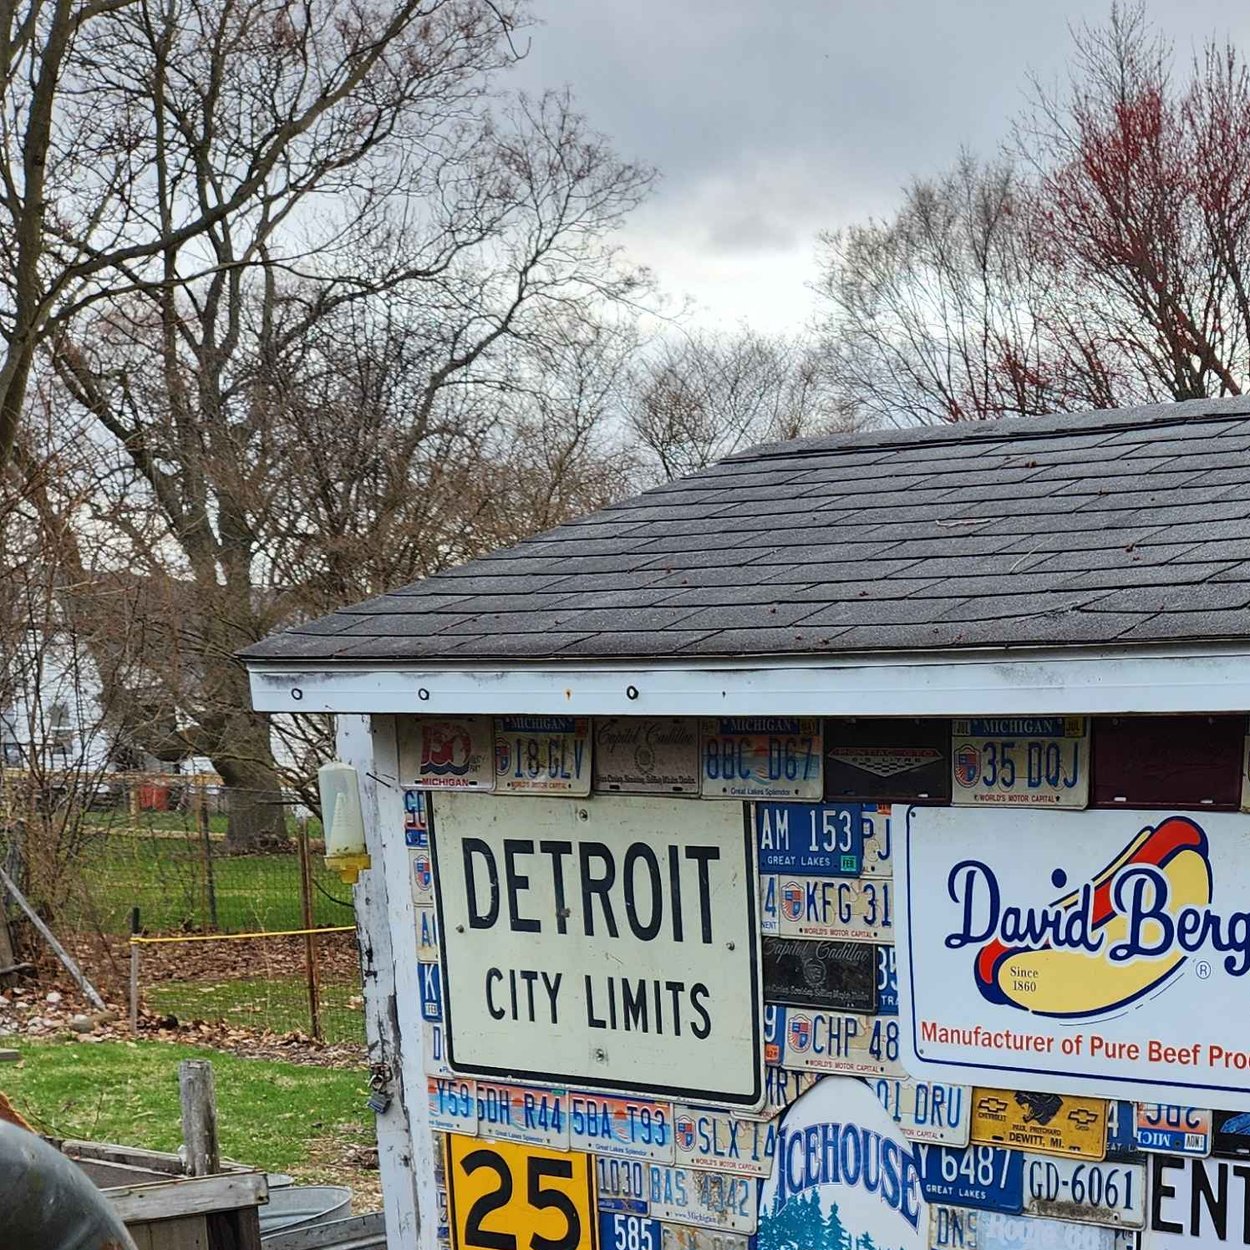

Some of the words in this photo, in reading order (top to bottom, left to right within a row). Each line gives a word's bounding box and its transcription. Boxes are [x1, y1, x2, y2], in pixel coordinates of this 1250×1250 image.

[731, 719, 791, 732] MICHIGAN
[983, 718, 1052, 733] MICHIGAN
[768, 738, 813, 780] D67
[983, 742, 1015, 787] 35
[1027, 741, 1079, 789] DQJ
[422, 778, 468, 787] MICHIGAN
[979, 794, 1006, 802] WORLD'S
[1008, 794, 1030, 803] MOTOR
[1031, 795, 1055, 803] CAPITAL
[760, 808, 789, 850] AM
[809, 809, 851, 852] 153
[767, 856, 796, 866] GREAT
[801, 856, 830, 866] LAKES
[460, 837, 721, 945] DETROIT
[807, 881, 850, 924] KFG
[944, 859, 1106, 953] David
[804, 928, 828, 936] WORLD'S
[850, 931, 873, 939] CAPITAL
[1009, 965, 1039, 979] Since
[1012, 979, 1037, 993] 1860
[485, 967, 563, 1025] CITY
[584, 974, 712, 1041] LIMITS
[813, 1014, 857, 1058] CHP
[870, 1020, 898, 1062] 48
[921, 1022, 1054, 1054] Manufacturer
[1061, 1036, 1082, 1056] of
[1090, 1037, 1140, 1060] Pure
[1148, 1041, 1201, 1065] Beef
[810, 1060, 834, 1070] WORLD'S
[836, 1062, 854, 1070] MOTOR
[856, 1064, 878, 1072] CAPITAL
[525, 1093, 561, 1134] R44
[915, 1083, 961, 1128] DRU
[627, 1107, 665, 1147] T93
[699, 1117, 740, 1159] SLX
[916, 1131, 938, 1139] CAPITAL
[777, 1122, 921, 1235] ICEHOUSE
[941, 1145, 1013, 1191] 6487
[1029, 1160, 1133, 1210] GD-6061
[926, 1184, 953, 1196] GREAT
[959, 1189, 986, 1200] LAKES
